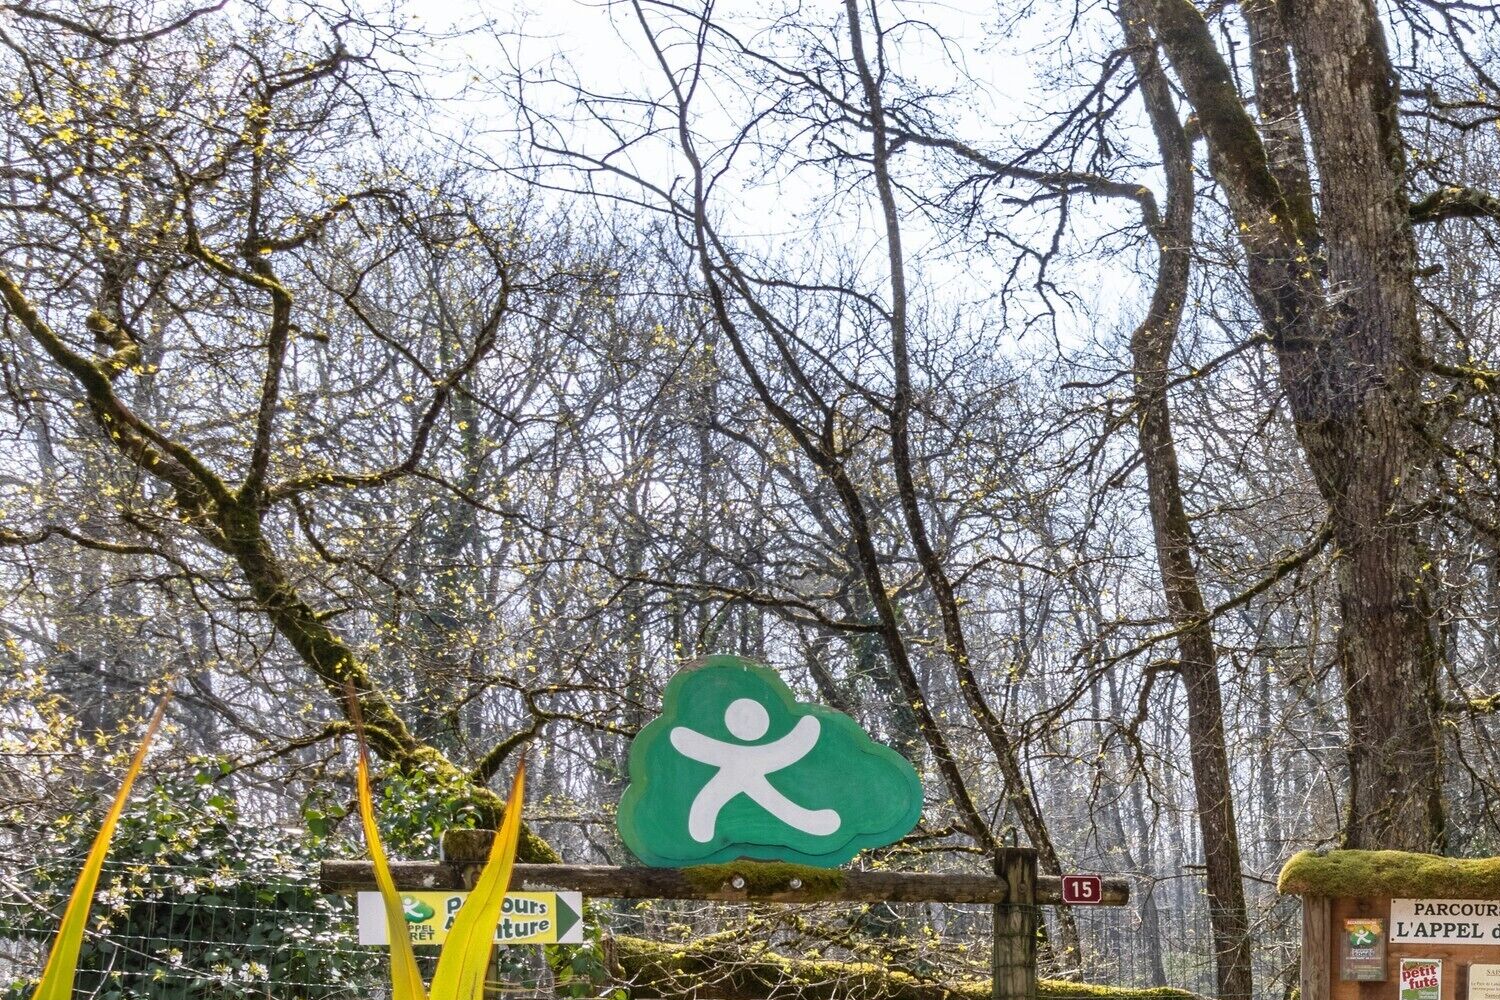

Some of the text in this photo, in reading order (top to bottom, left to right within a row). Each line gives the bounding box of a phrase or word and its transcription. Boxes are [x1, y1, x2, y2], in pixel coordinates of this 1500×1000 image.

[1072, 881, 1092, 898] 15
[447, 896, 547, 914] Pours
[1396, 921, 1484, 938] L'APPEL
[1402, 965, 1437, 982] petit
[1409, 976, 1438, 990] futé
